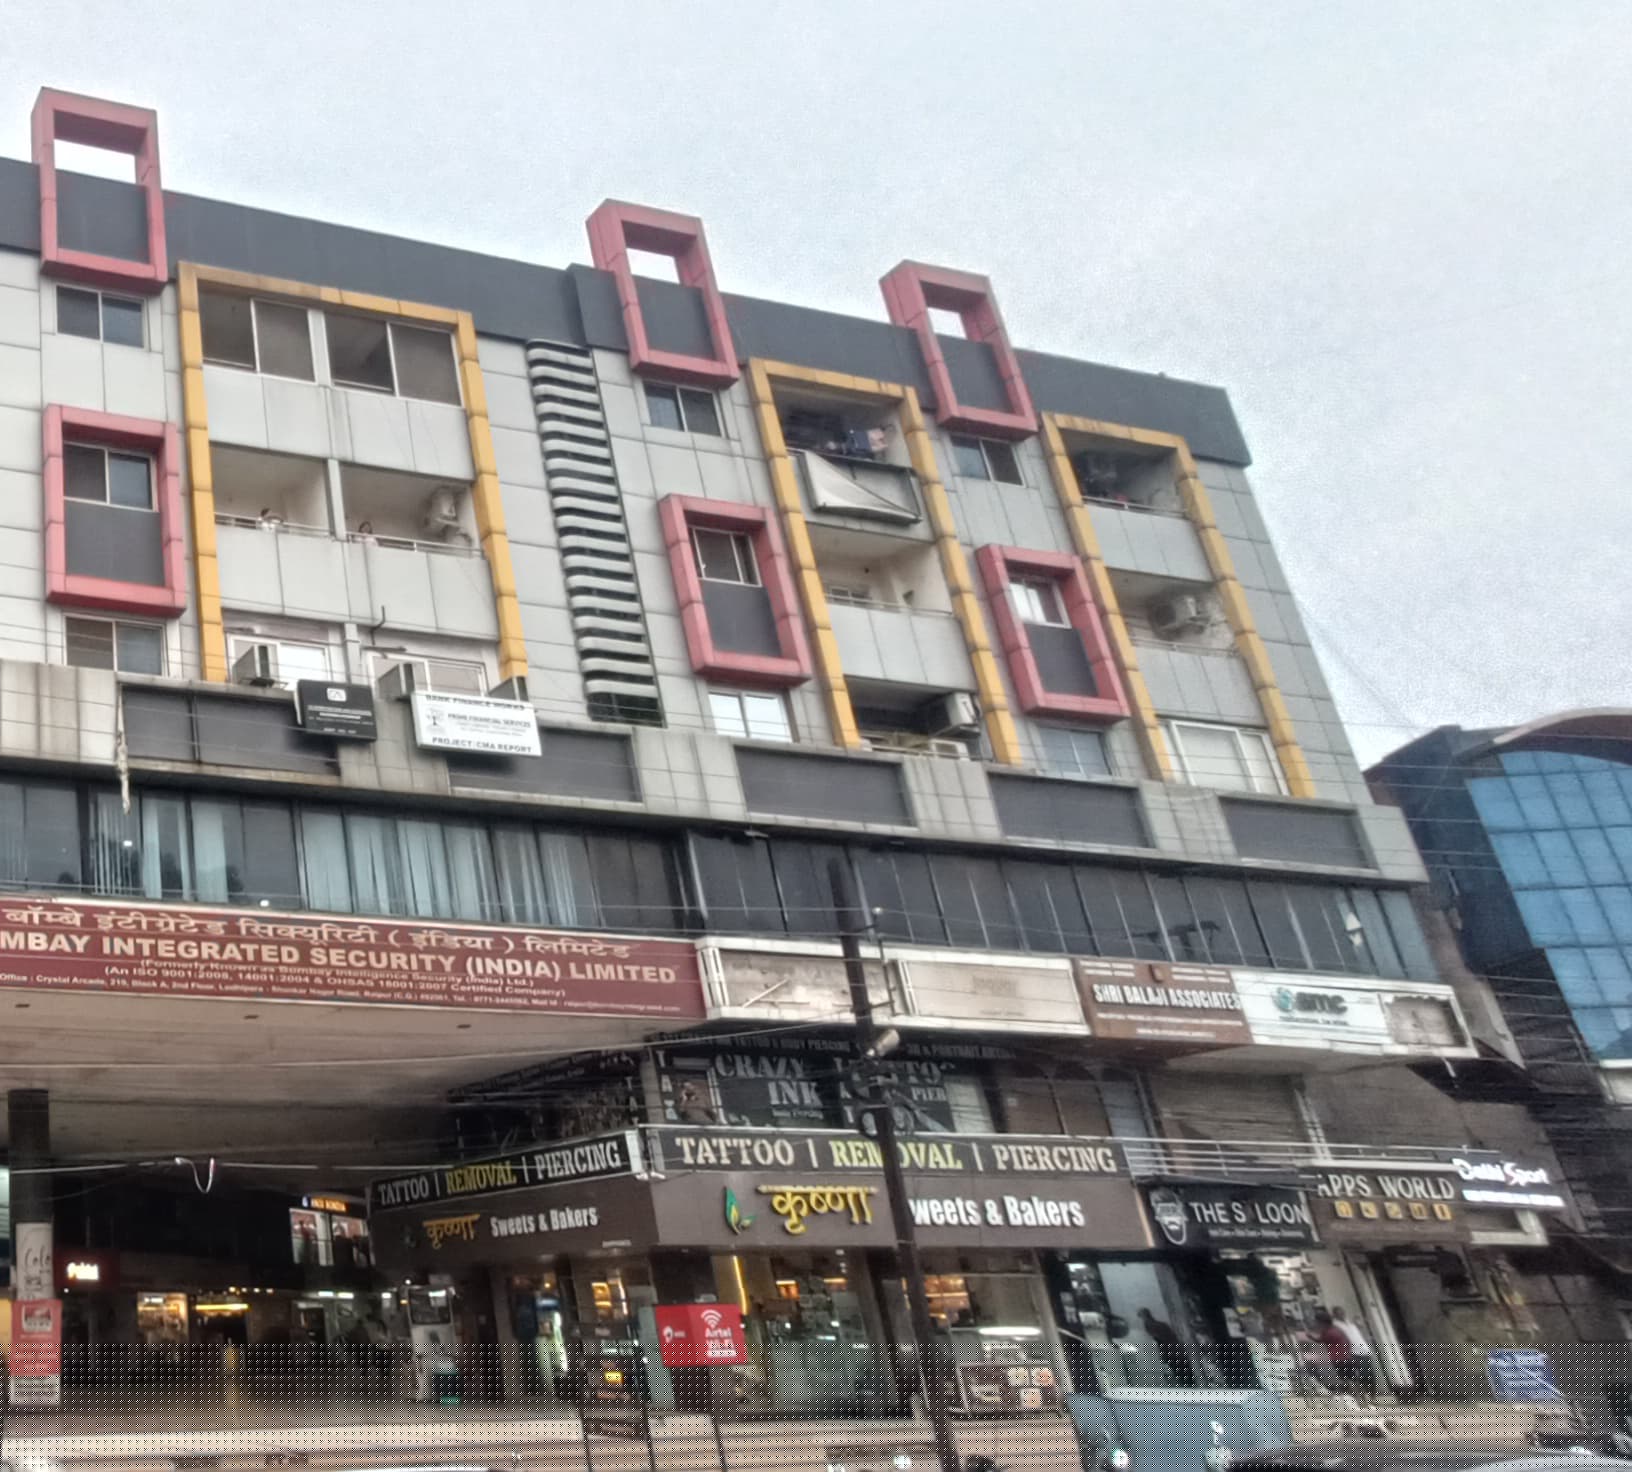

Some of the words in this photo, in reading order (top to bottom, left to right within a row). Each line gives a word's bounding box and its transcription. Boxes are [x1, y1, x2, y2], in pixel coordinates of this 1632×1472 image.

[1, 905, 85, 928] बॉम्बे
[93, 910, 228, 937] इंटीग्रेटेड
[522, 935, 631, 959] लिमिटेड
[101, 936, 300, 965] INTEGRATED
[309, 947, 456, 973] SECURITY
[466, 956, 562, 983] (INDIA)
[569, 962, 677, 984] LIMITED
[0, 973, 28, 982] Office
[35, 974, 70, 985] Crystal
[132, 968, 158, 977] ISO
[451, 983, 503, 994] Certified
[504, 986, 566, 998] Company)
[1092, 983, 1124, 1004] SHRI
[1123, 985, 1169, 1007] BALAJI
[1168, 987, 1242, 1010] ASSOCIATES
[715, 1053, 805, 1080] CRAZY
[767, 1080, 824, 1108] INK
[675, 1136, 795, 1166] TATTOO
[991, 1143, 1118, 1173] PIERCING
[377, 1177, 430, 1206] TATTOO
[444, 1160, 517, 1195] REMOVAL
[534, 1141, 622, 1180] PIERCING
[1376, 1174, 1456, 1200] WORLD
[490, 1213, 536, 1238] Sweets
[538, 1213, 548, 1232] &
[550, 1205, 599, 1231] Bakers
[908, 1196, 982, 1227] weets
[984, 1198, 1003, 1226] &
[1003, 1195, 1087, 1228] Bakers
[1188, 1202, 1231, 1224] THE
